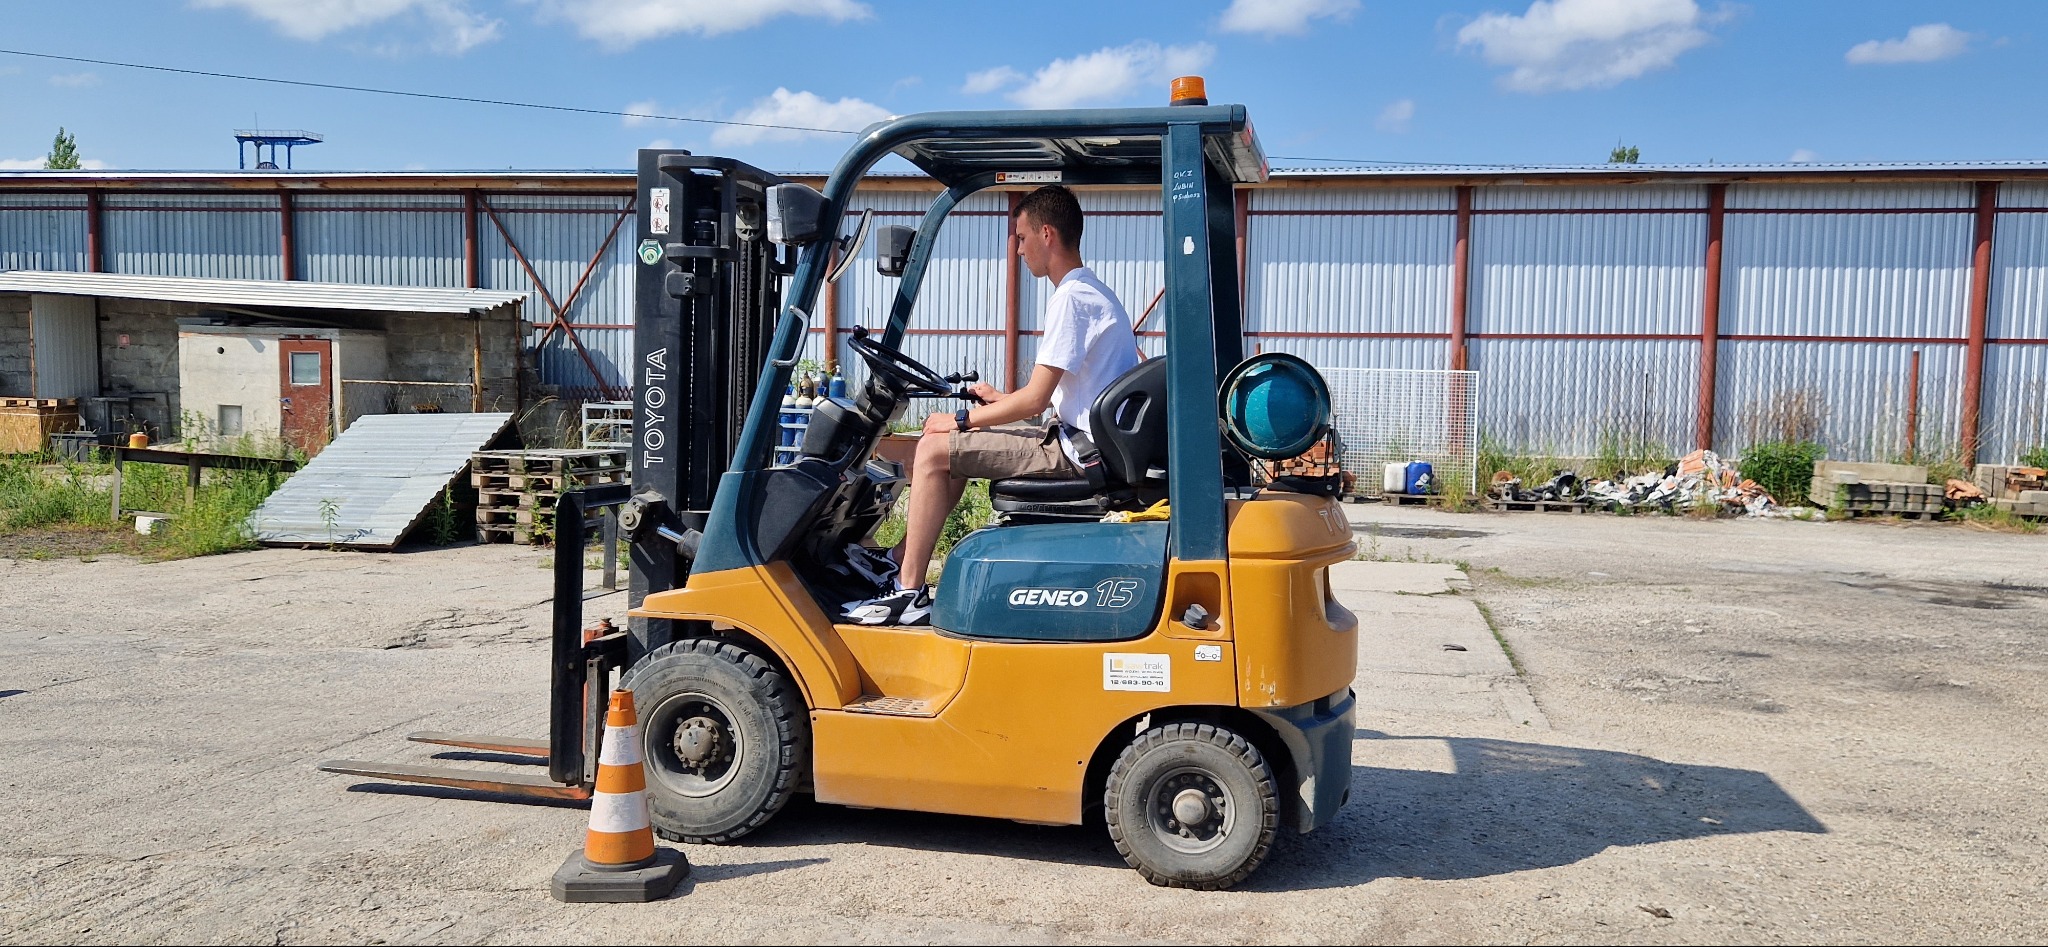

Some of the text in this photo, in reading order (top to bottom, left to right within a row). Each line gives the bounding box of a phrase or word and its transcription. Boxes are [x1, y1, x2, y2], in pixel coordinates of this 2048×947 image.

[643, 347, 667, 469] TOYOTA
[1009, 580, 1138, 608] GENEO 15
